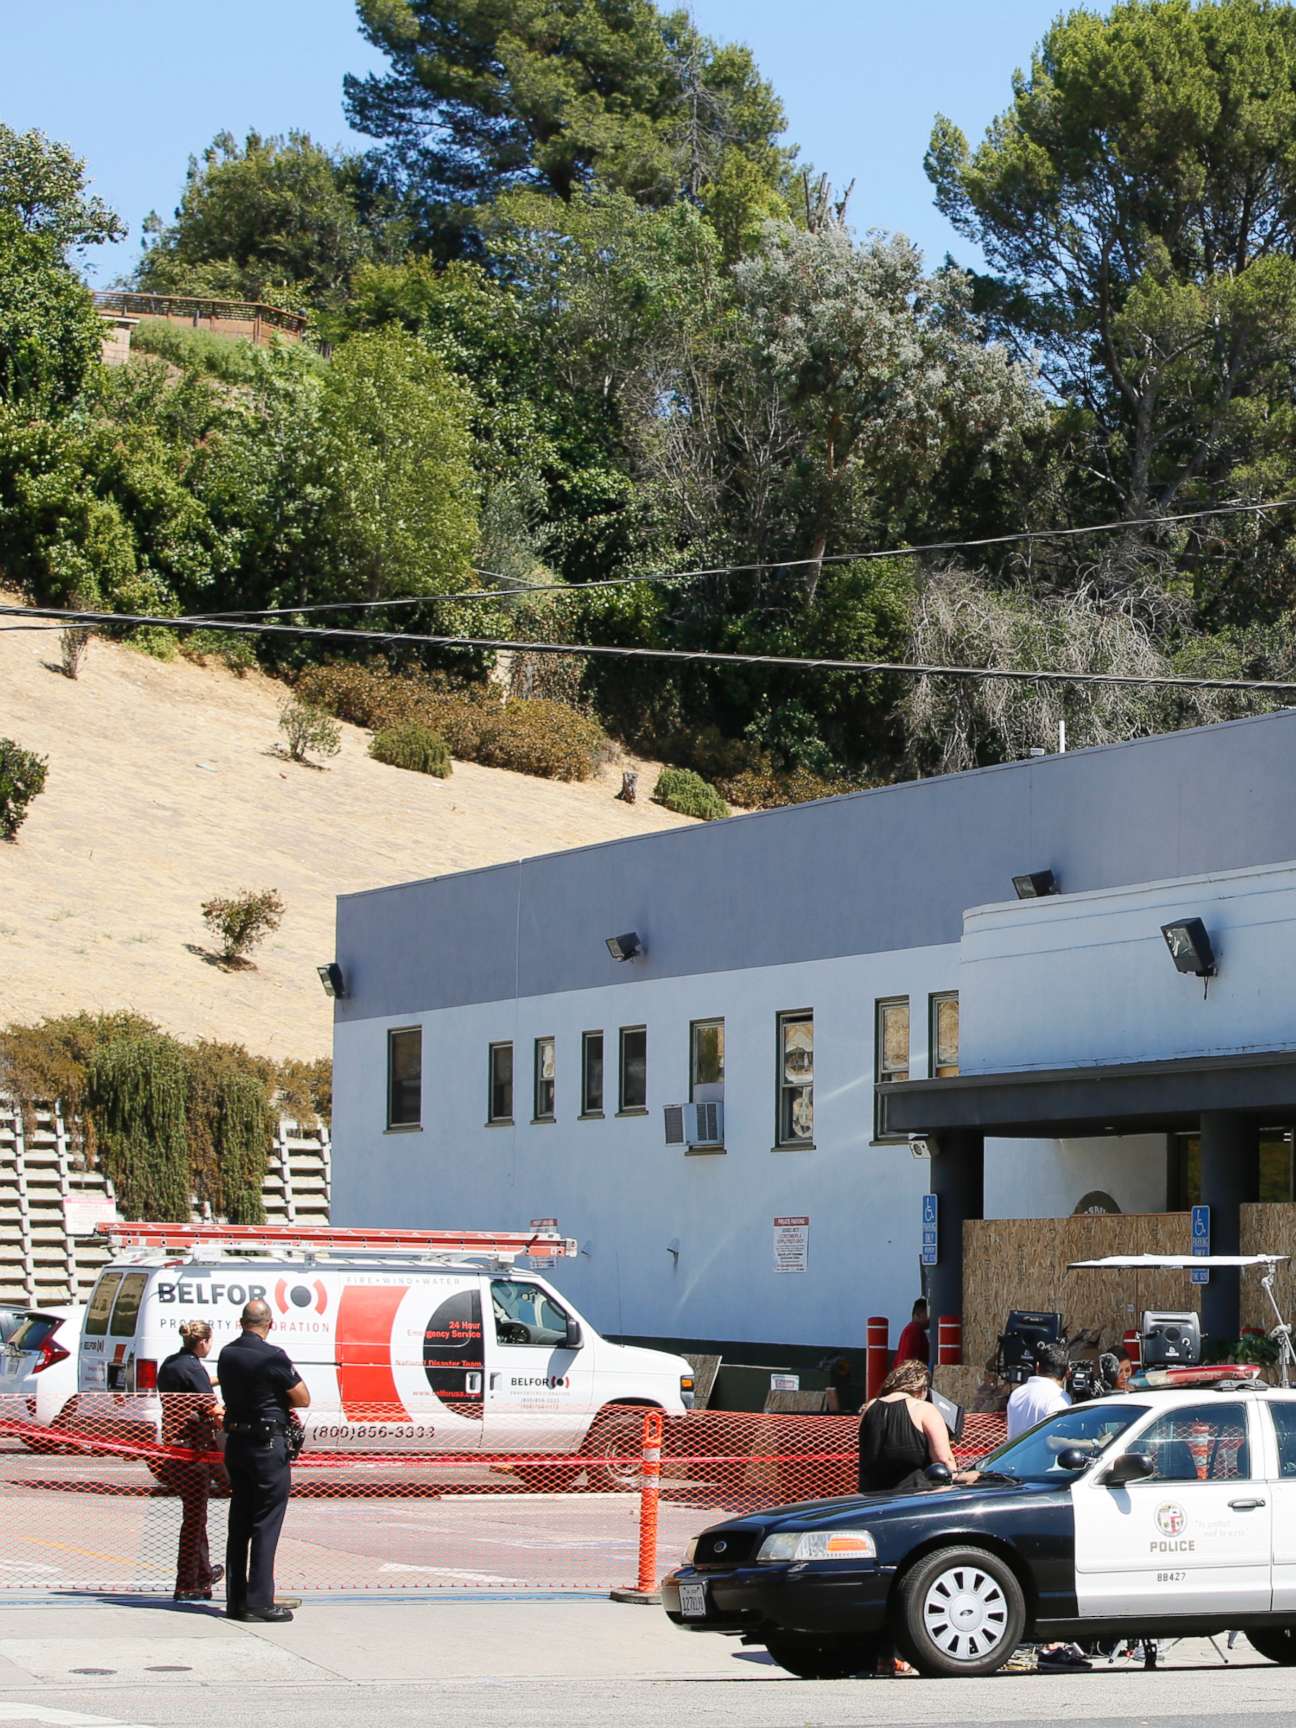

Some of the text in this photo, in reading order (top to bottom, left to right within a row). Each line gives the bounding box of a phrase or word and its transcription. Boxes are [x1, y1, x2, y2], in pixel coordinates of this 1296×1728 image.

[158, 1282, 266, 1305] BELFOR
[448, 1320, 481, 1329] 24 Hour
[451, 1329, 481, 1338] Service
[511, 1377, 550, 1387] BELFOR
[1150, 1540, 1195, 1553] POLICE
